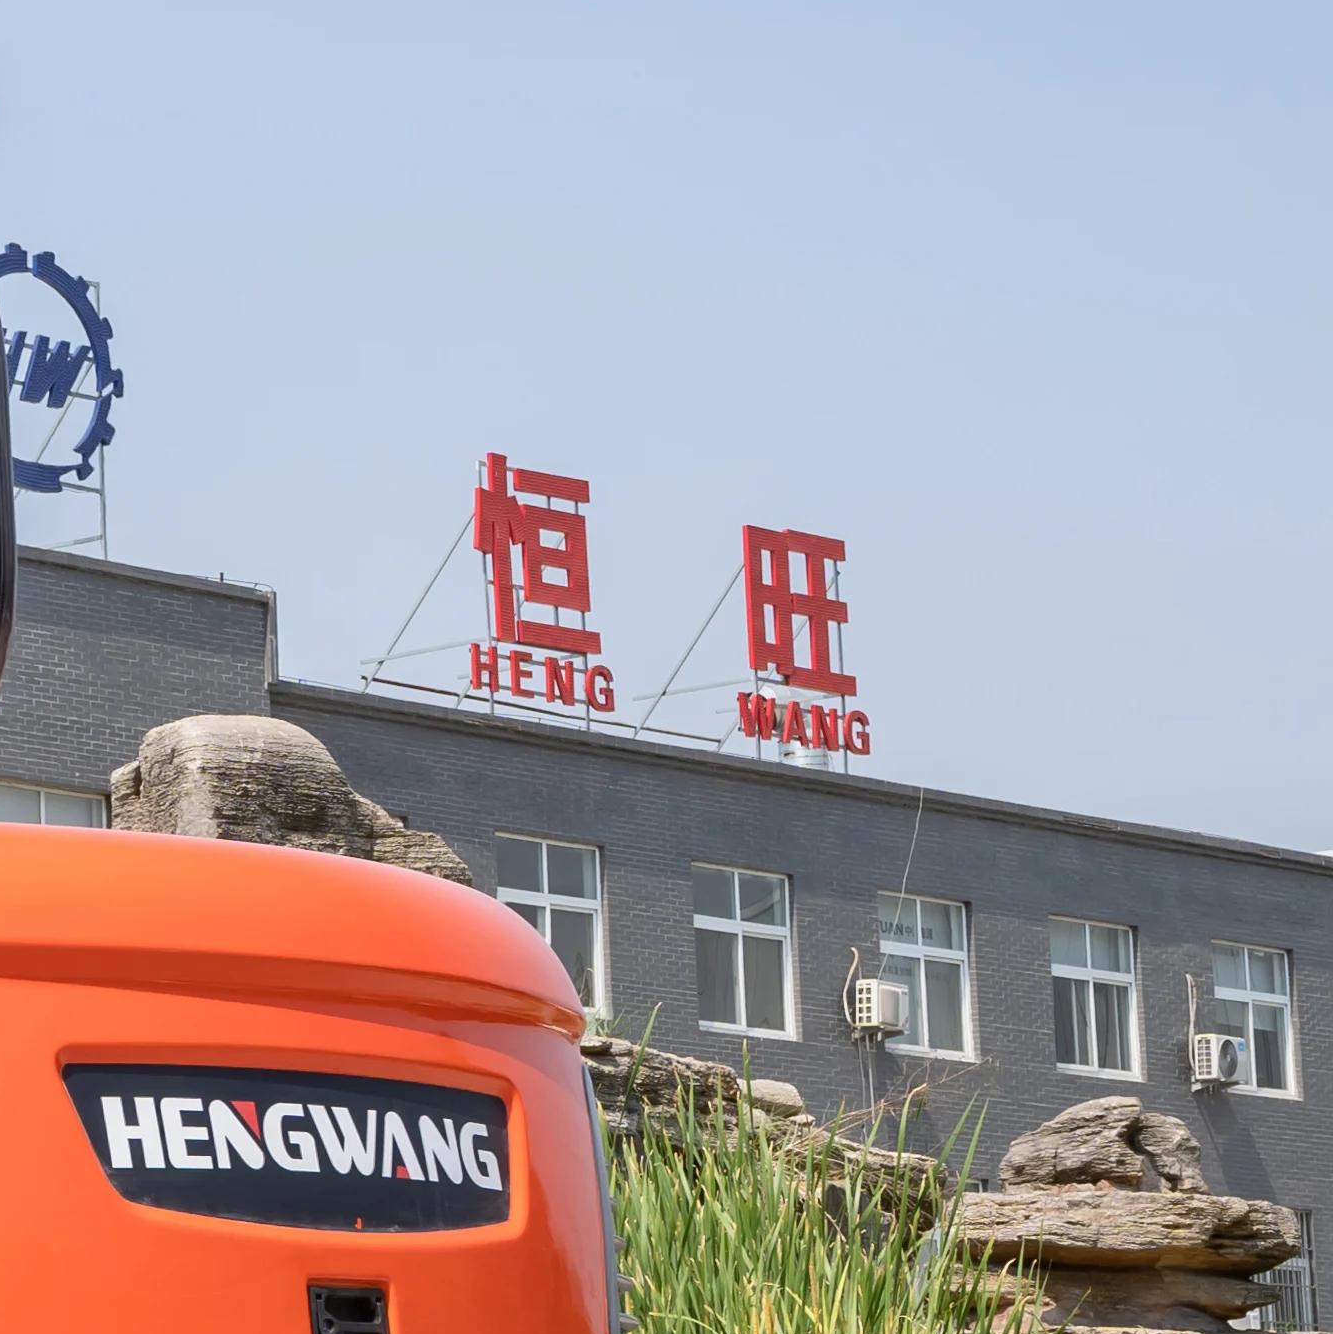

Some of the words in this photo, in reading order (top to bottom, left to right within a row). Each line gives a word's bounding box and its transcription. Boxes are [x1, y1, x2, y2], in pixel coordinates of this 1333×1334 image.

[469, 642, 615, 712] HENG
[737, 691, 871, 756] WANG
[100, 1095, 503, 1191] HENGWANG
